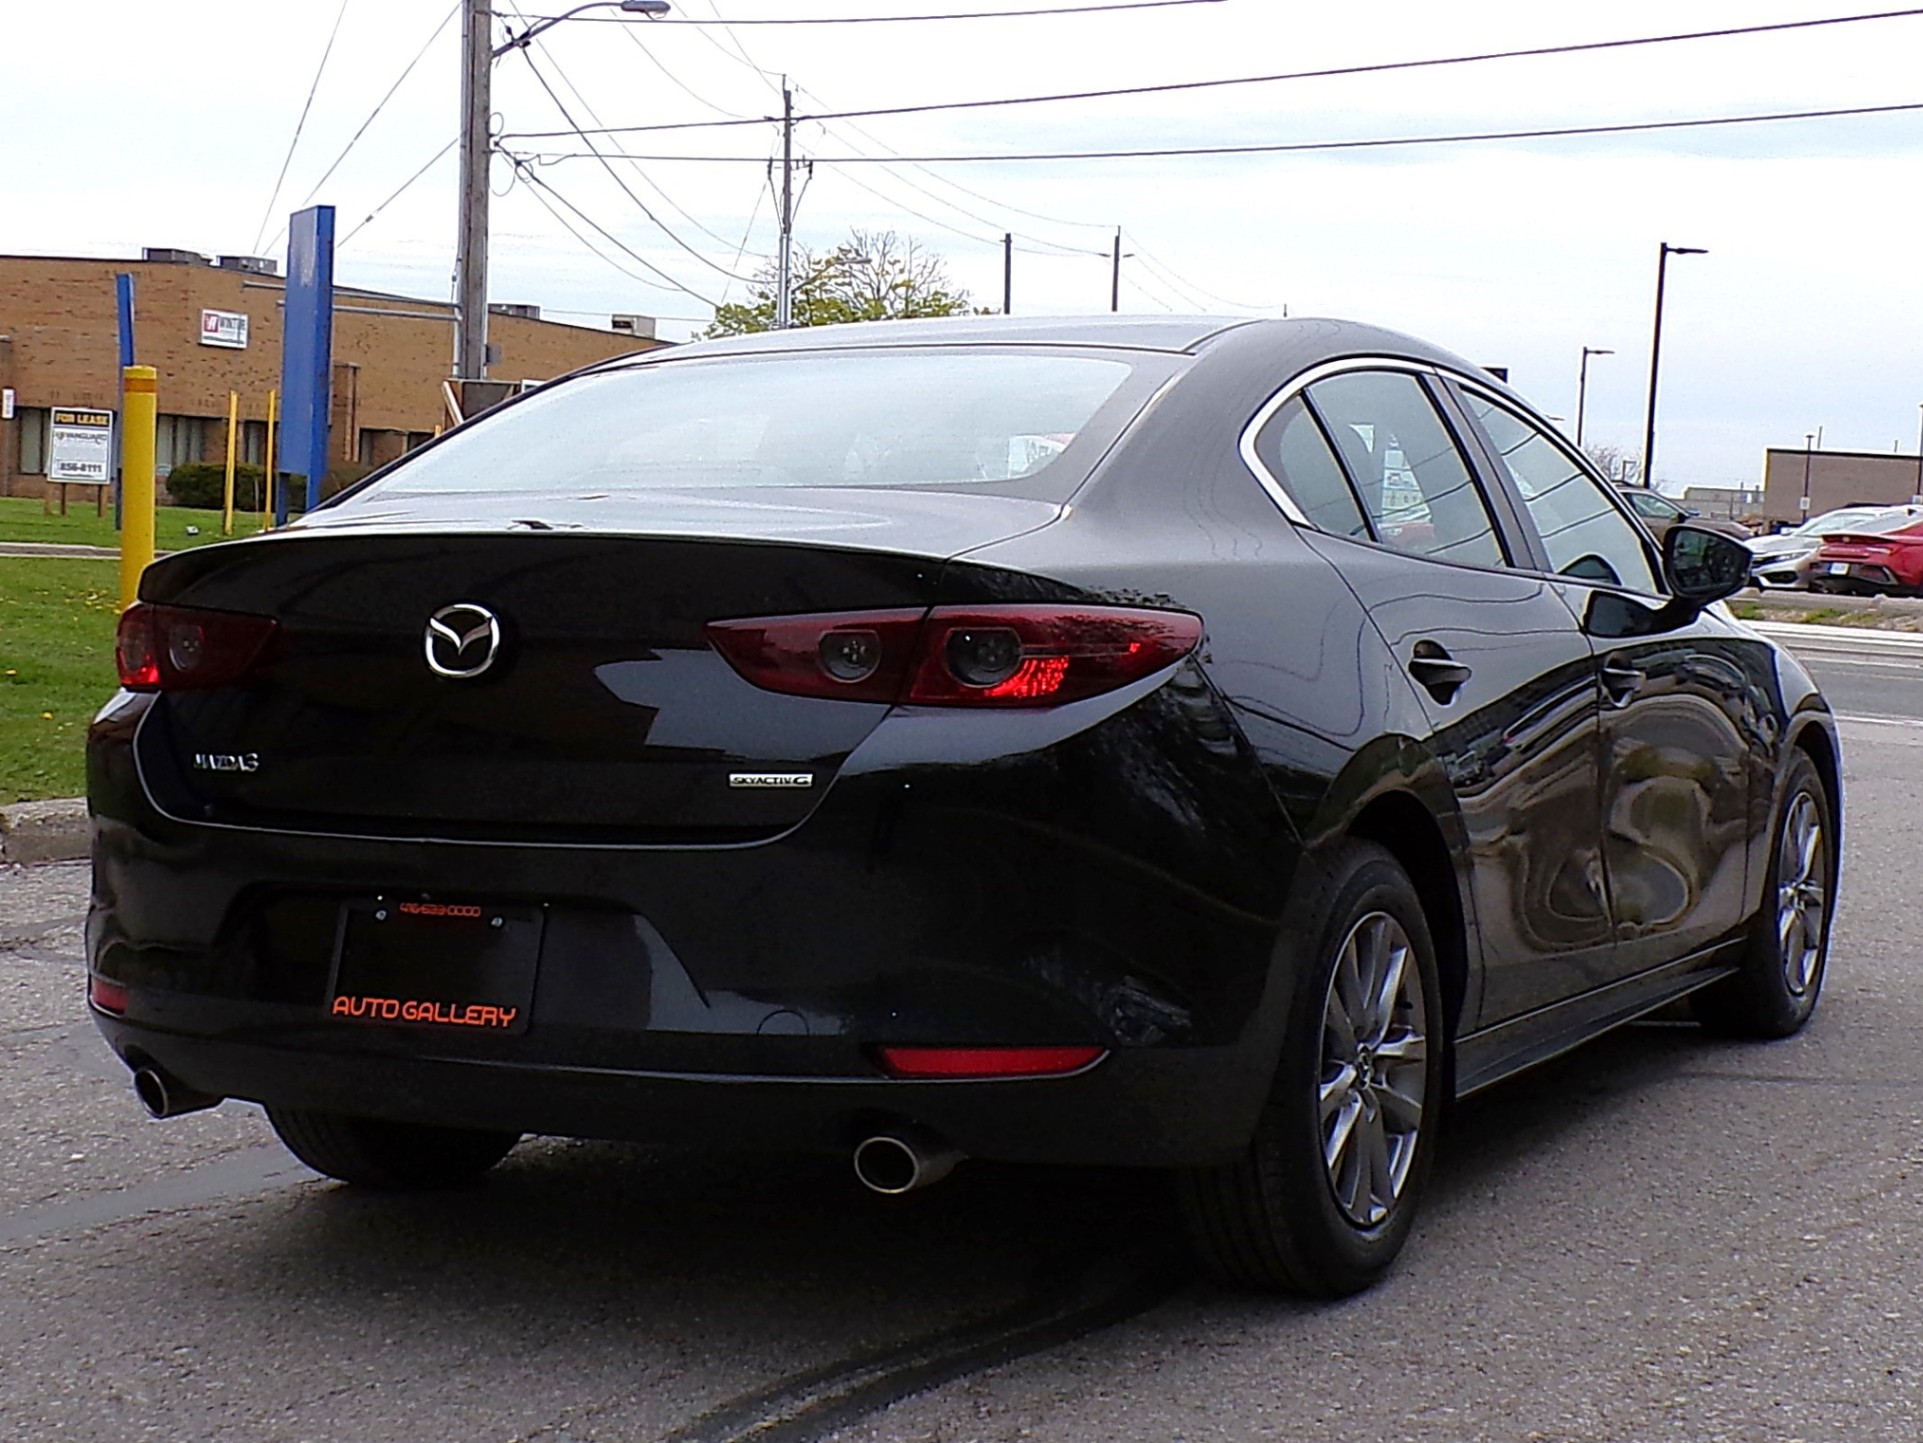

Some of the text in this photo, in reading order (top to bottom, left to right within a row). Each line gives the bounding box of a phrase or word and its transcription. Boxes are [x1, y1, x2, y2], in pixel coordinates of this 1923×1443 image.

[56, 413, 108, 425] FOR LEASE
[332, 996, 516, 1027] AUTO GALLERY
